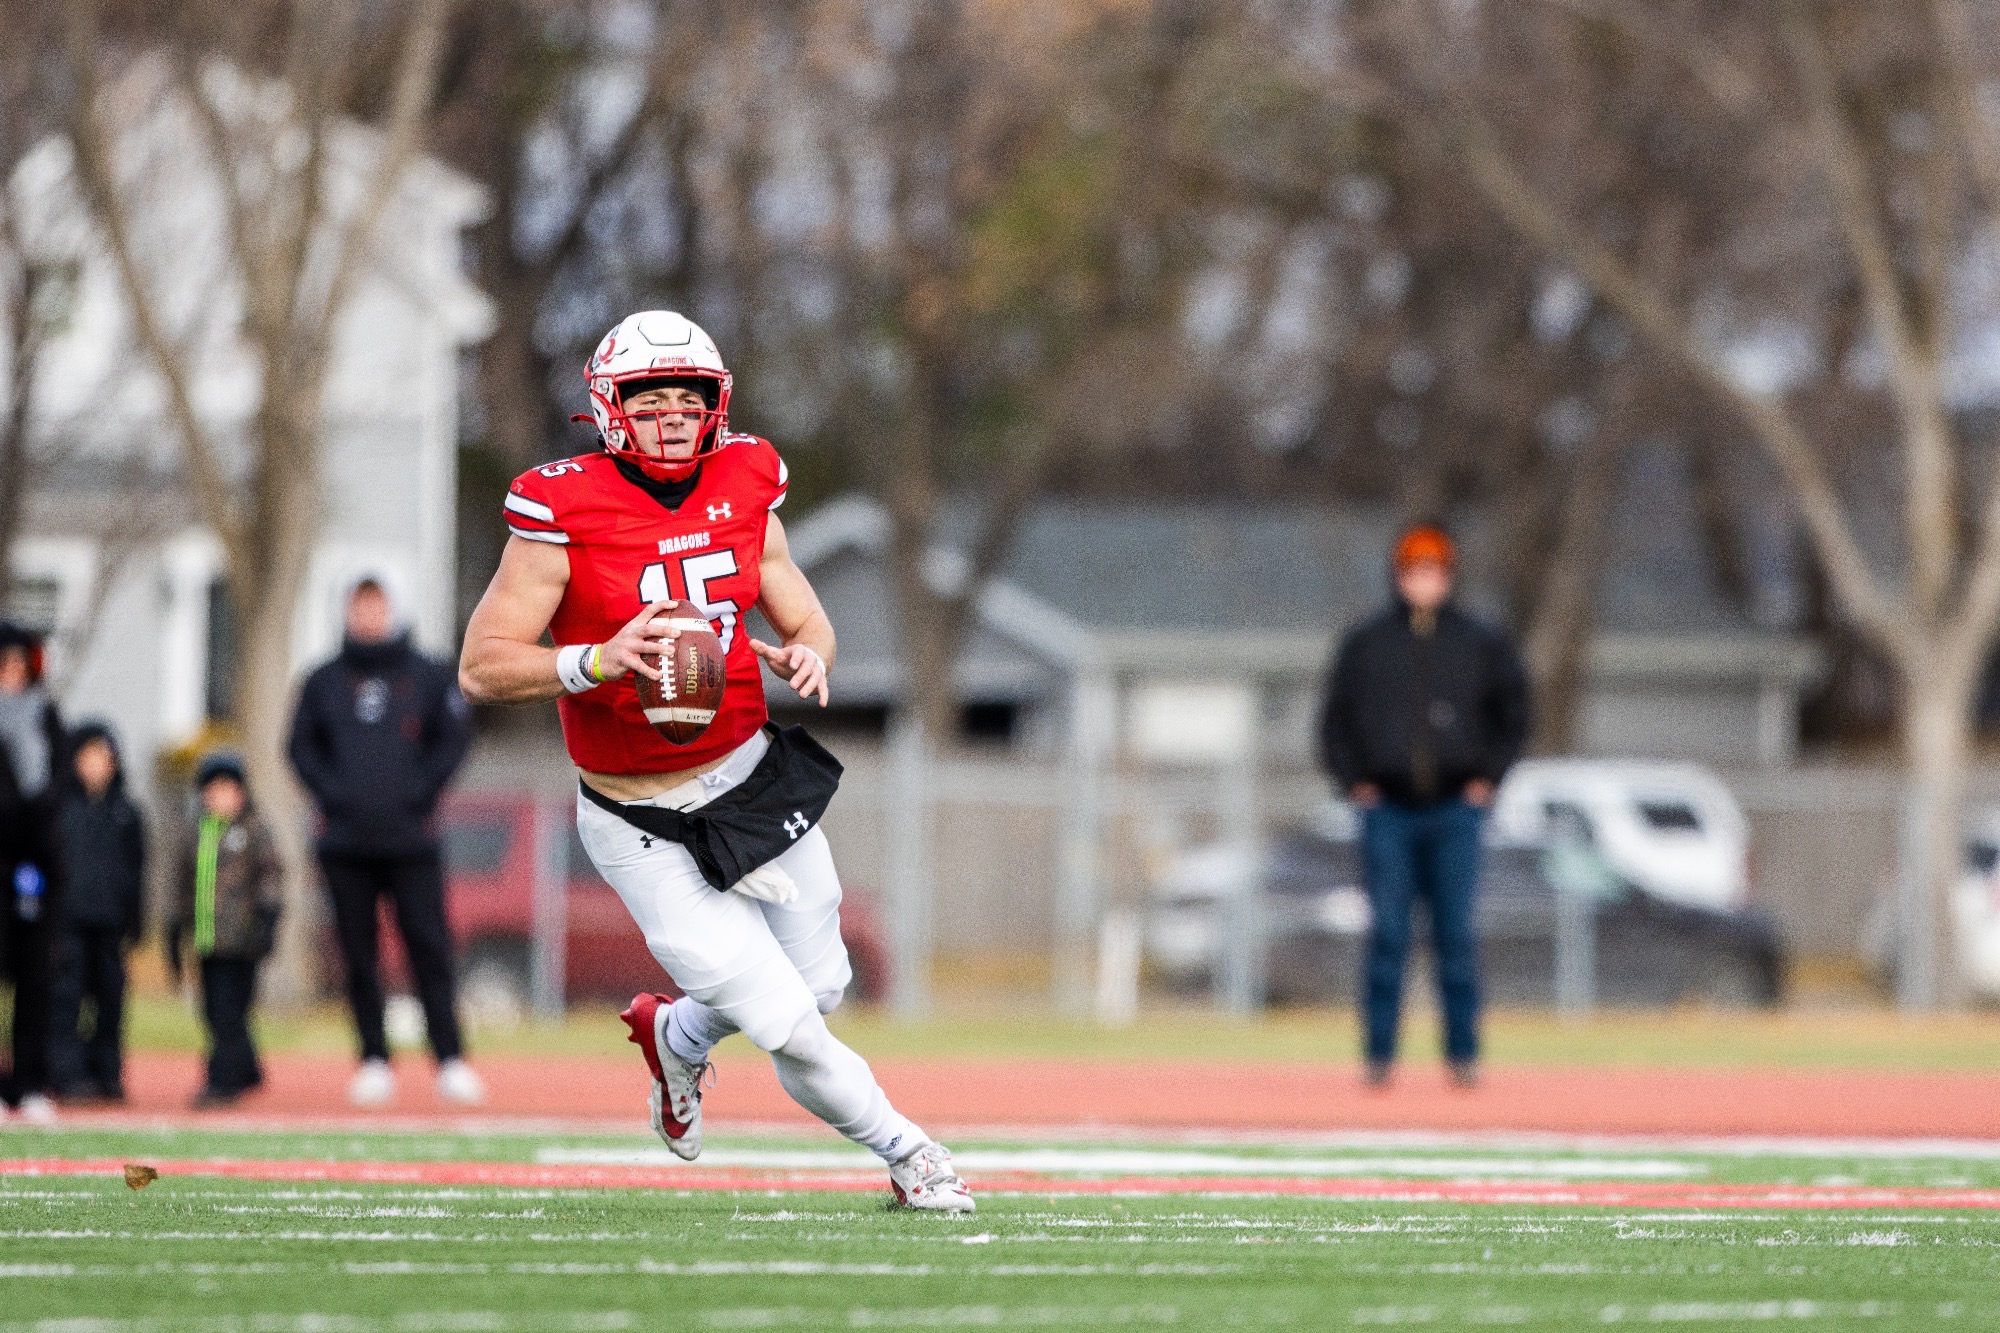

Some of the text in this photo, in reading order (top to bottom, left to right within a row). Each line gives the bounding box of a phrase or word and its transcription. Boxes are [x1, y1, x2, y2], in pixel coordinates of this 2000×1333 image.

[658, 356, 687, 365] DRAGONS
[658, 532, 711, 555] DRAGONS
[637, 547, 740, 657] 15
[685, 646, 698, 695] Wilson
